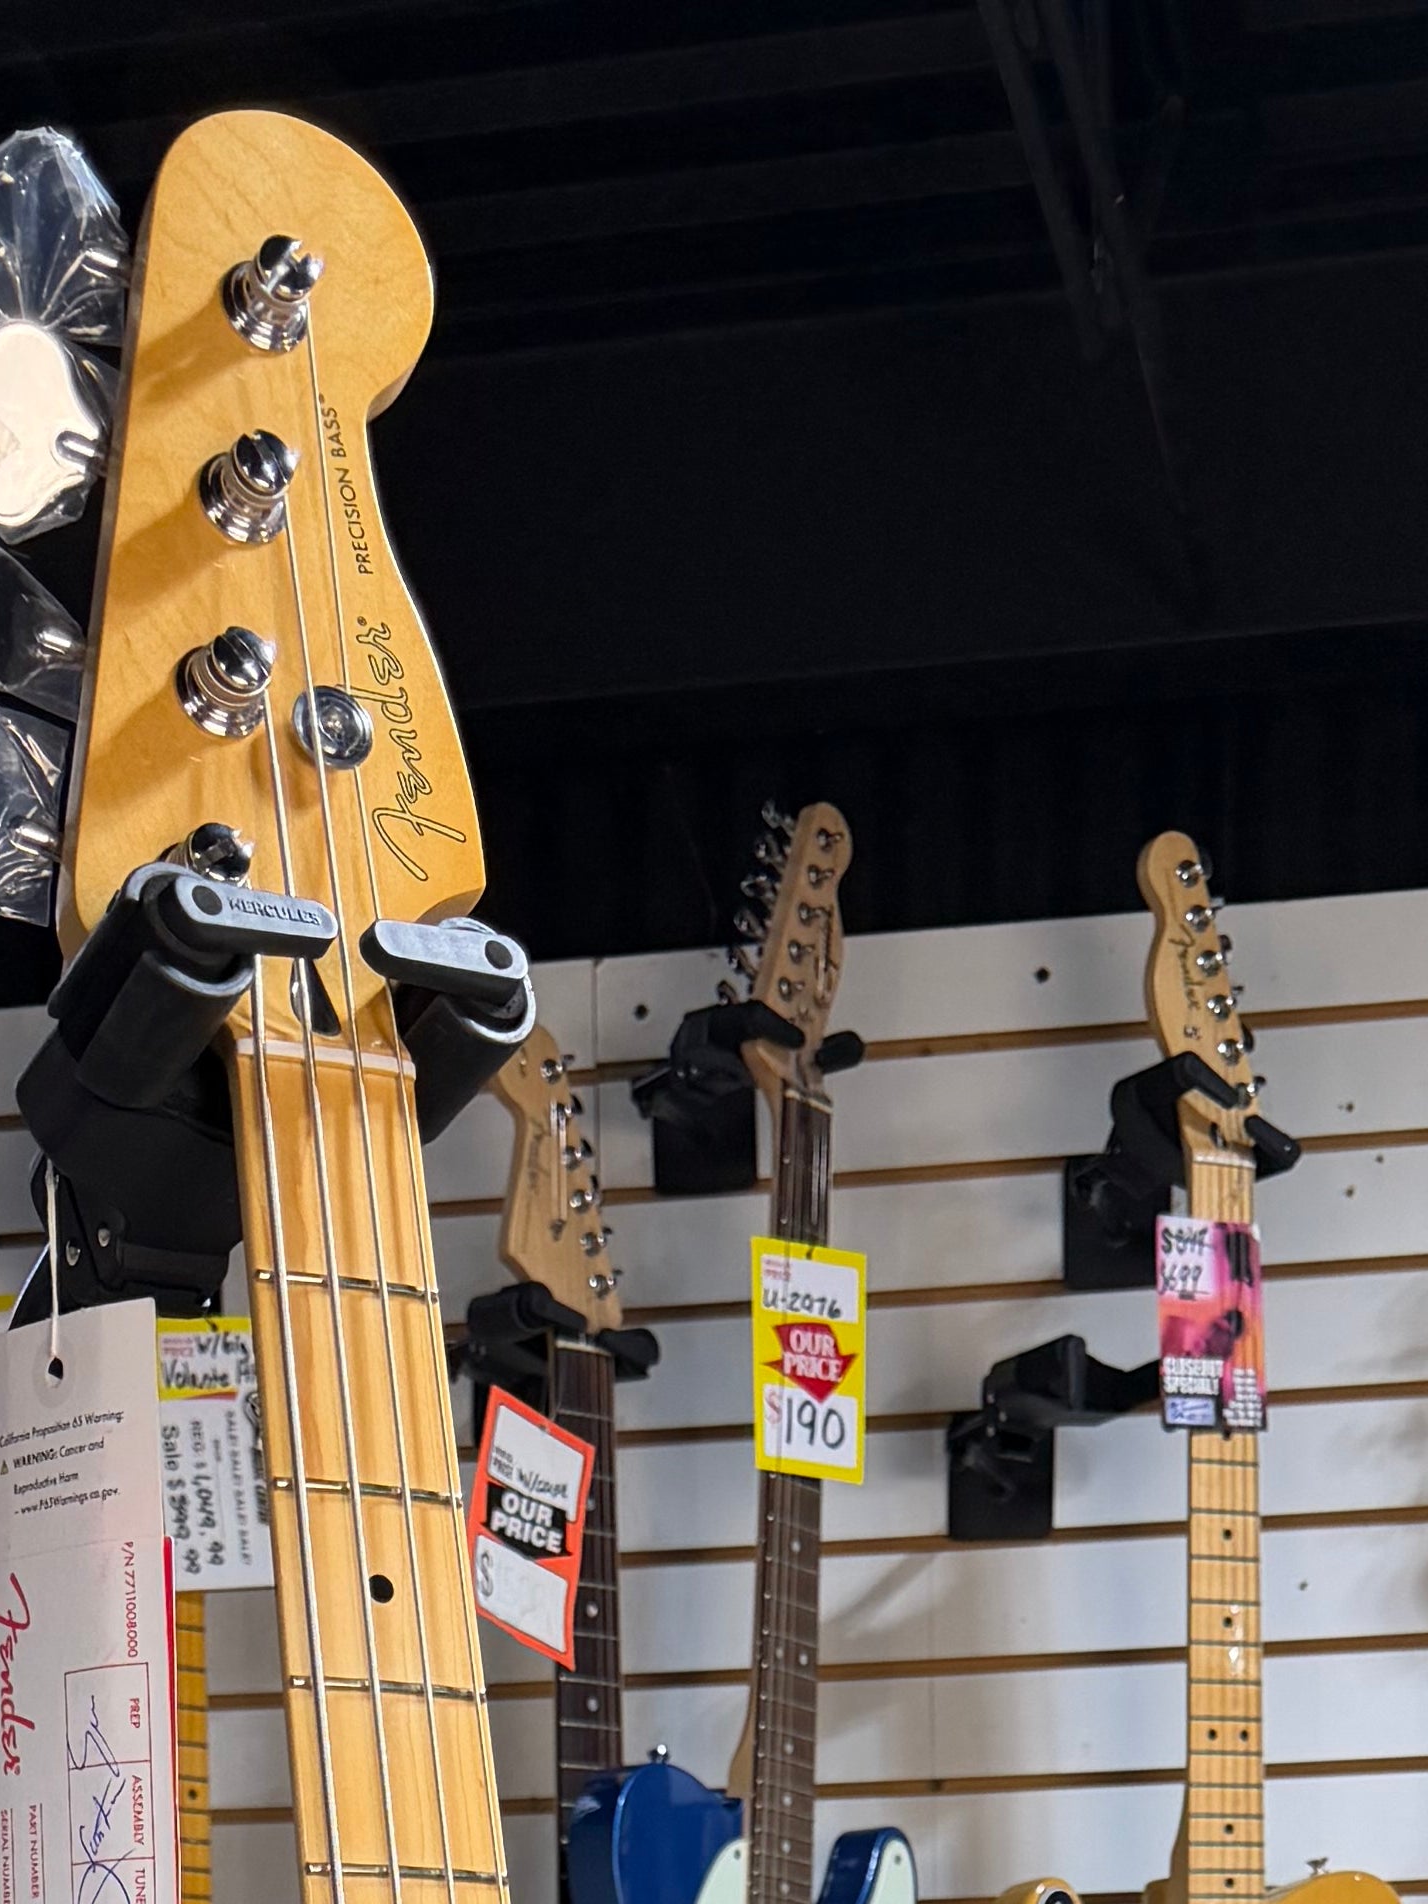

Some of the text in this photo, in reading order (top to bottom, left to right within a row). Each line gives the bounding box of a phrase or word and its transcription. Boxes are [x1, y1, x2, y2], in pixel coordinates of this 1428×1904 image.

[338, 466, 374, 577] PRECISION
[350, 622, 467, 882] Fender
[227, 896, 321, 926] HERCULES
[789, 1329, 835, 1357] OUR
[783, 1353, 843, 1383] PRICE
[59, 1444, 87, 1458] Cancer
[88, 1437, 104, 1451] and
[162, 1425, 180, 1472] Sale
[58, 1472, 79, 1484] Harm
[501, 1492, 554, 1528] OUR
[489, 1510, 563, 1554] PRICE
[122, 1541, 139, 1658] P/N 7711008000
[128, 1697, 140, 1729] PREP
[0, 1810, 10, 1850] SERIAL
[131, 1774, 146, 1846] ASSEMBLY
[29, 1805, 40, 1899] PART NUMBER
